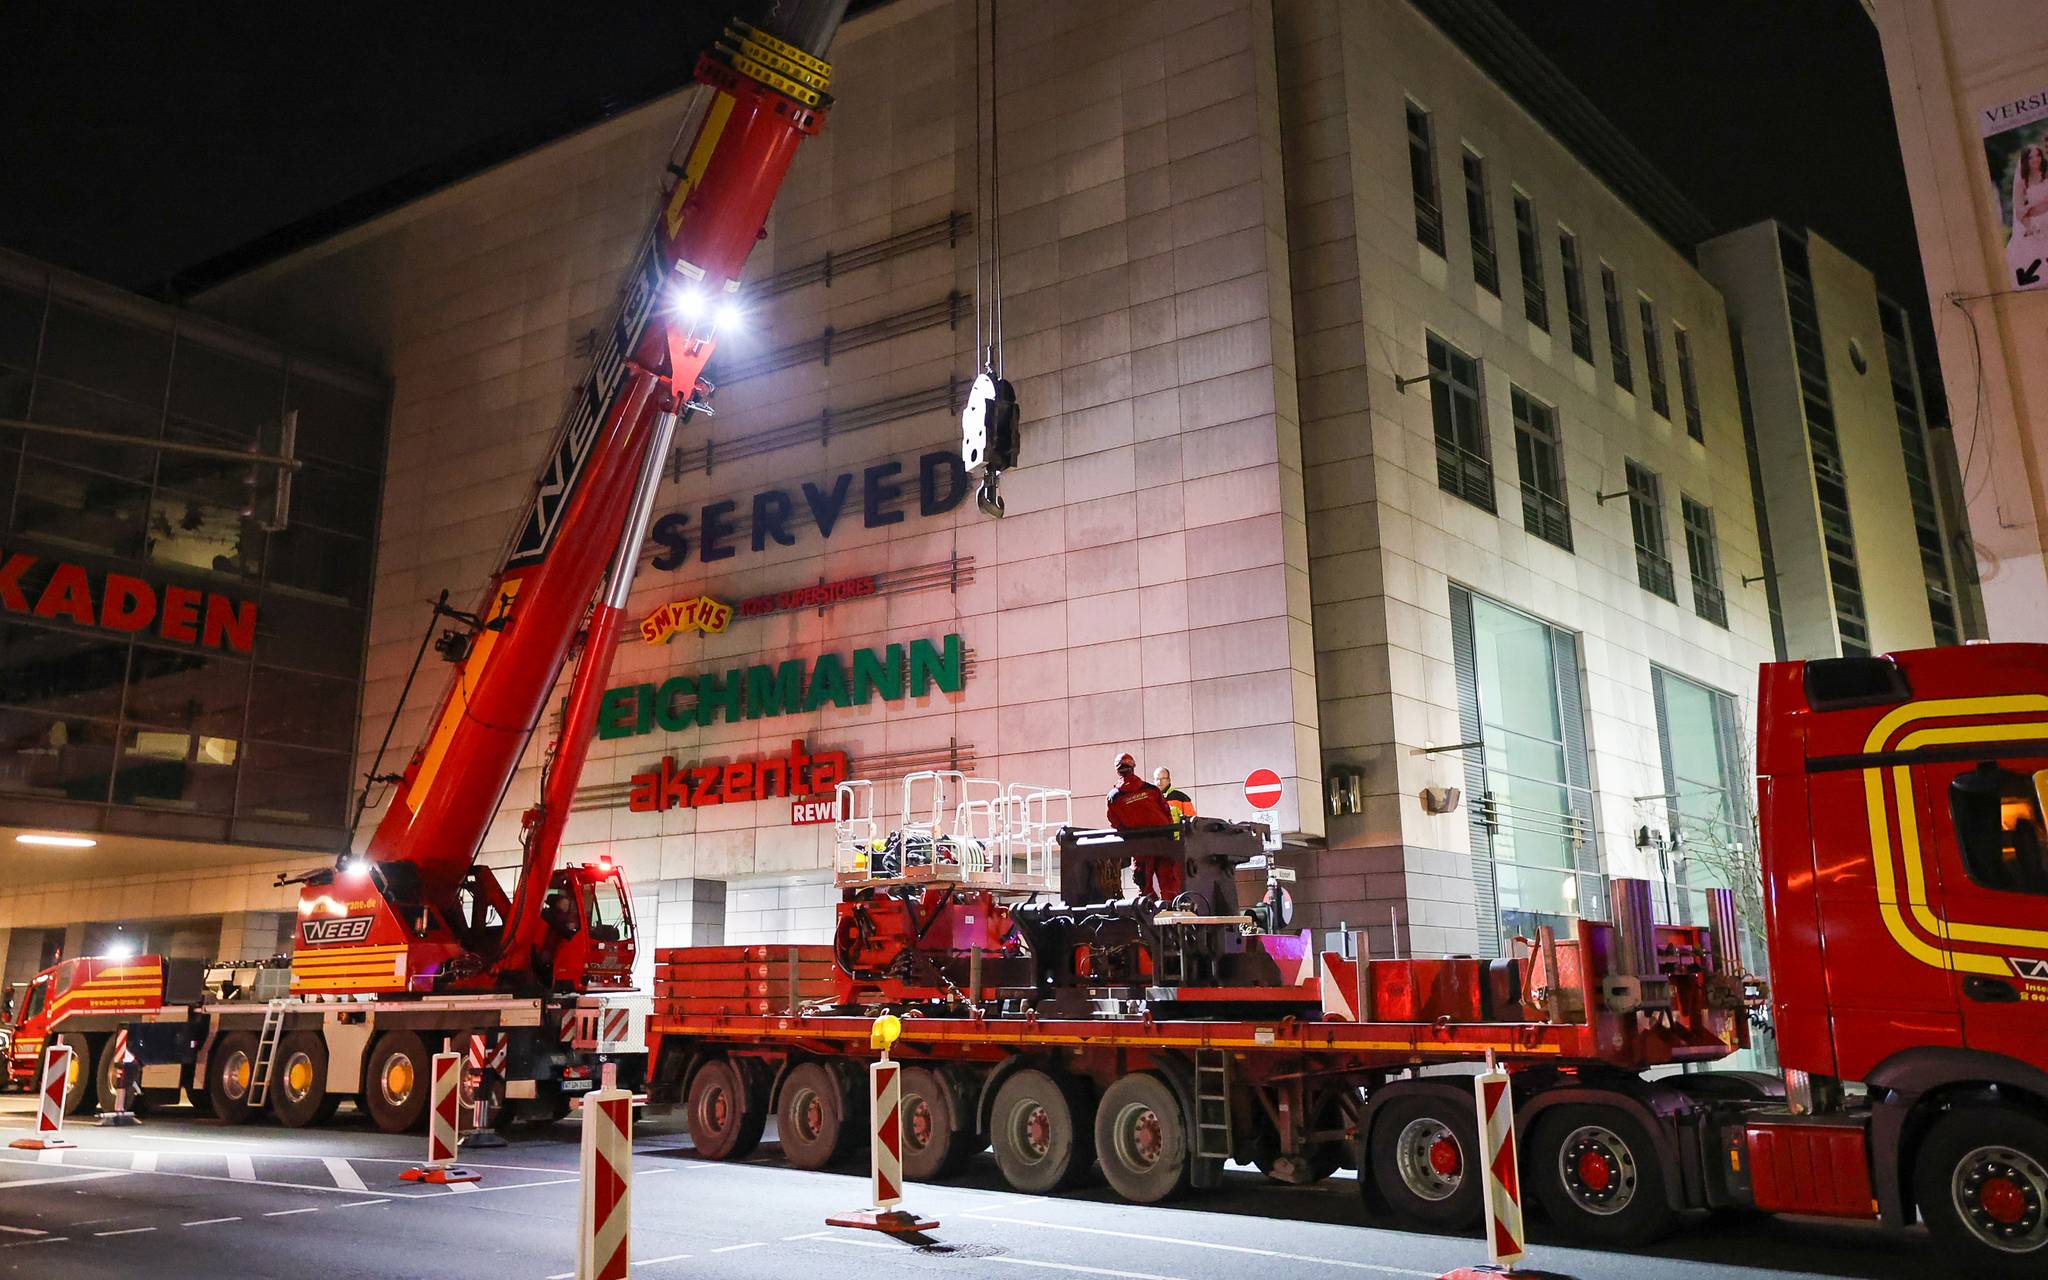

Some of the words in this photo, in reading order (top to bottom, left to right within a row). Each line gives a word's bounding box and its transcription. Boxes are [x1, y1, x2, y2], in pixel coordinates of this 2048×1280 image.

[636, 451, 968, 576] SERVED
[643, 602, 728, 641] SMYTHS
[779, 577, 876, 609] SUPERSTORES
[562, 633, 962, 741] EICHMANN
[630, 739, 847, 812] akzenta
[308, 921, 367, 939] NEEB
